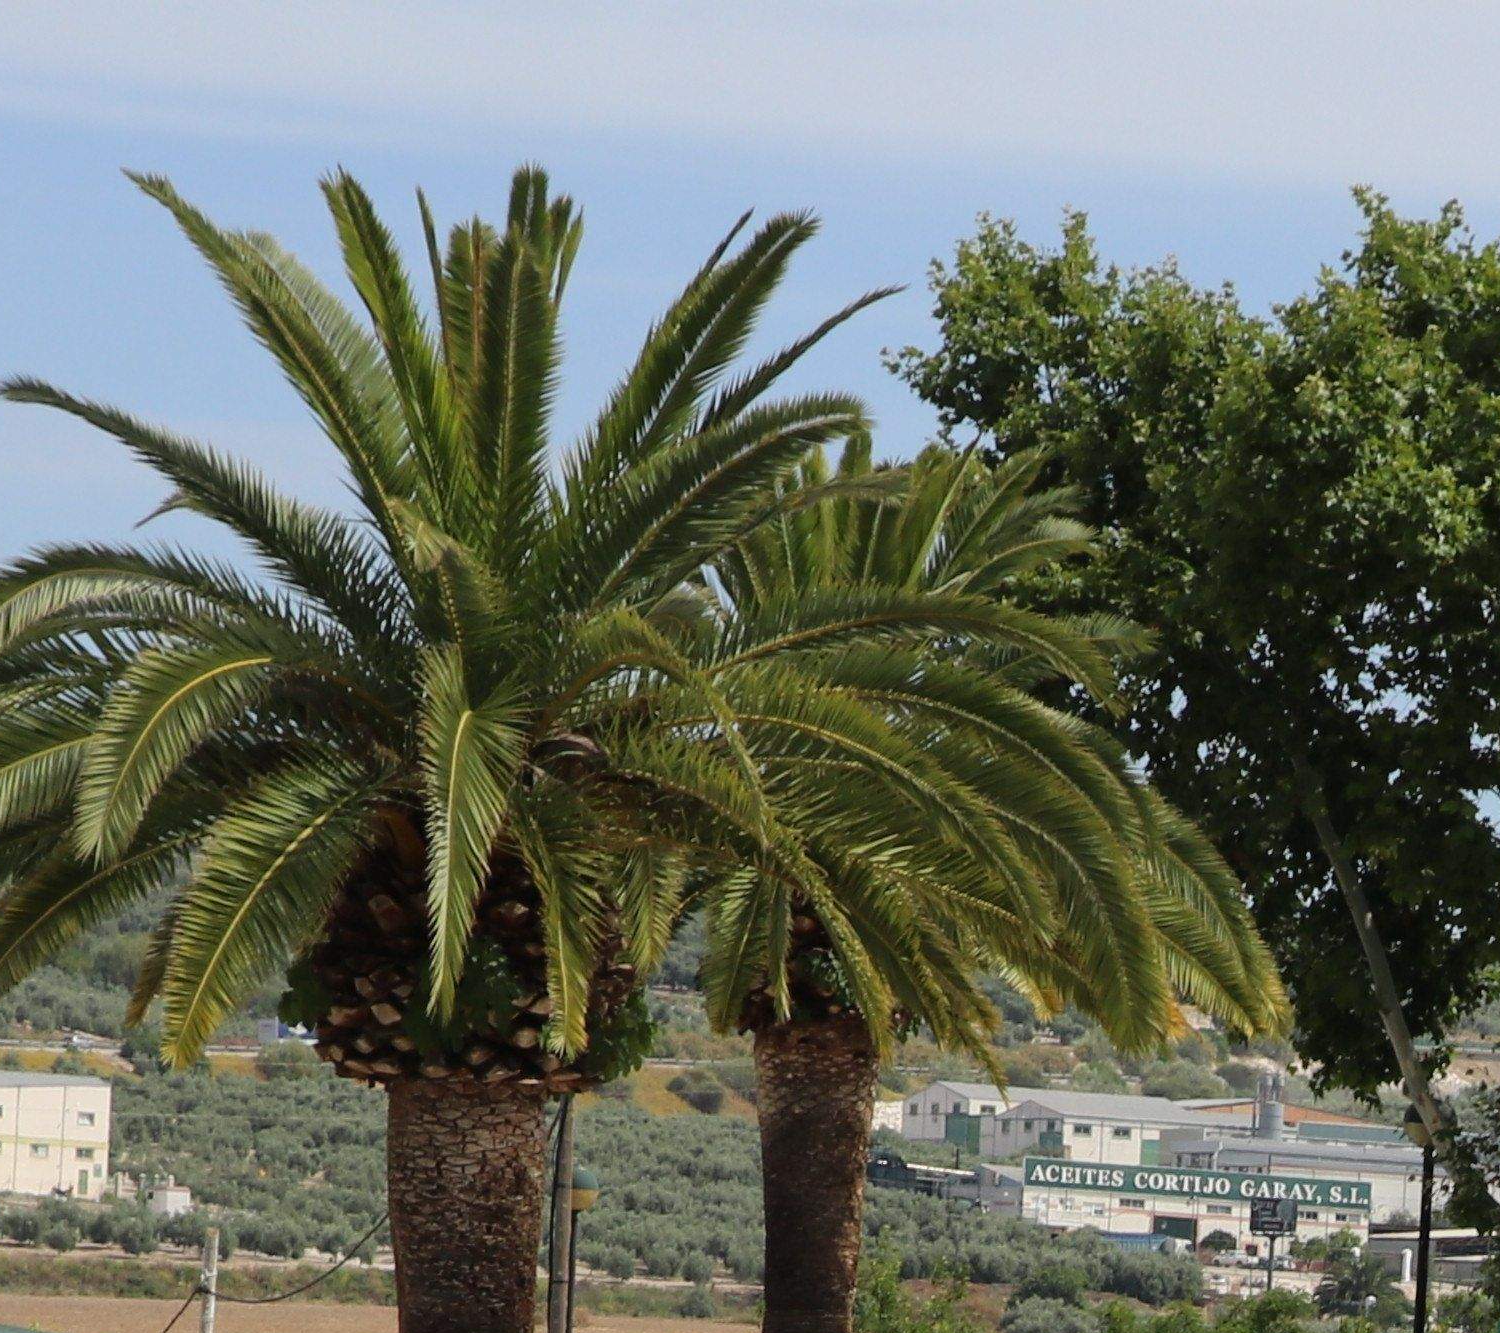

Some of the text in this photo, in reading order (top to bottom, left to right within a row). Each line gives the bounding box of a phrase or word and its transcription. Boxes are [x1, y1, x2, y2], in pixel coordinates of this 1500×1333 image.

[1029, 1163, 1370, 1206] ACEITES CORTIJO GARAY, S.L.
